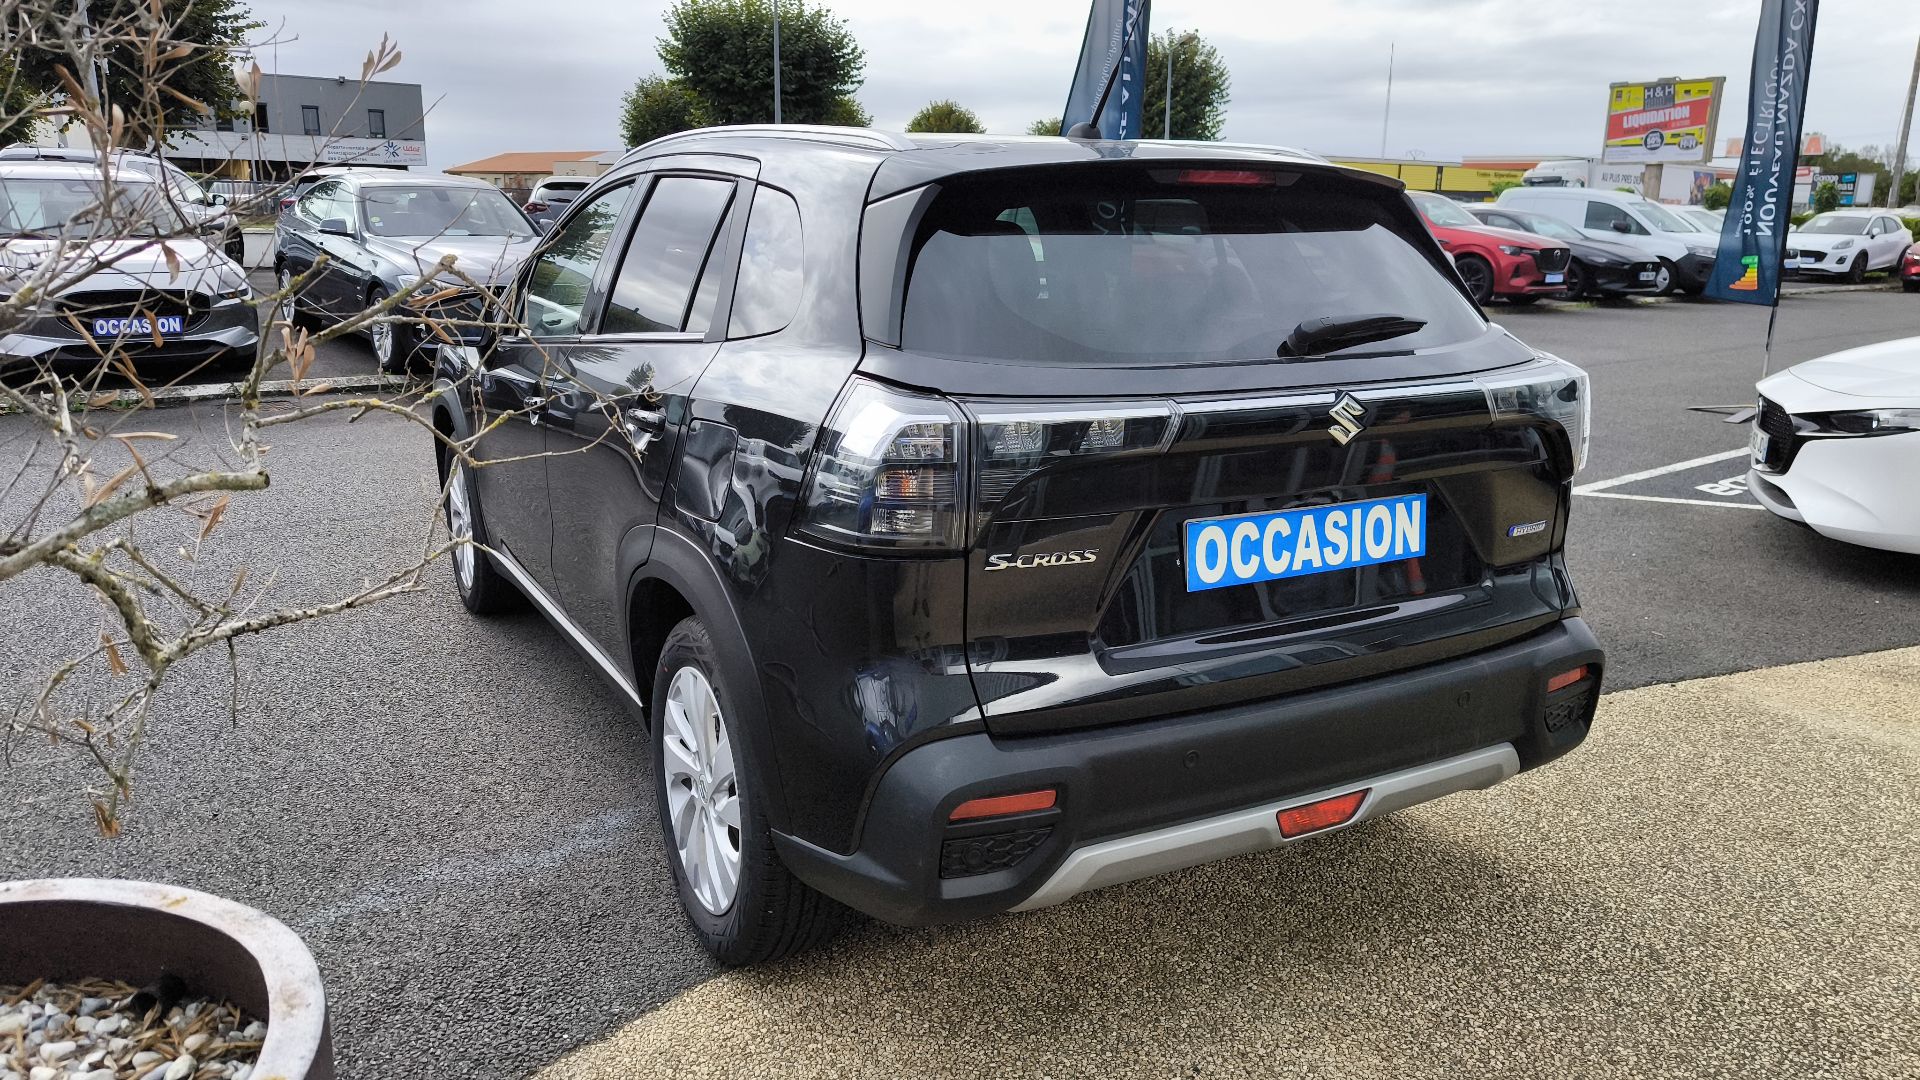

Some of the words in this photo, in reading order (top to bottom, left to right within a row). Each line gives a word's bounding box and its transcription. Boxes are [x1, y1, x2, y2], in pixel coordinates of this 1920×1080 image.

[1623, 105, 1690, 129] LIQUIDATION
[95, 318, 181, 335] OCCASON
[1195, 500, 1421, 584] OCCASION
[984, 548, 1100, 571] S-CROSS
